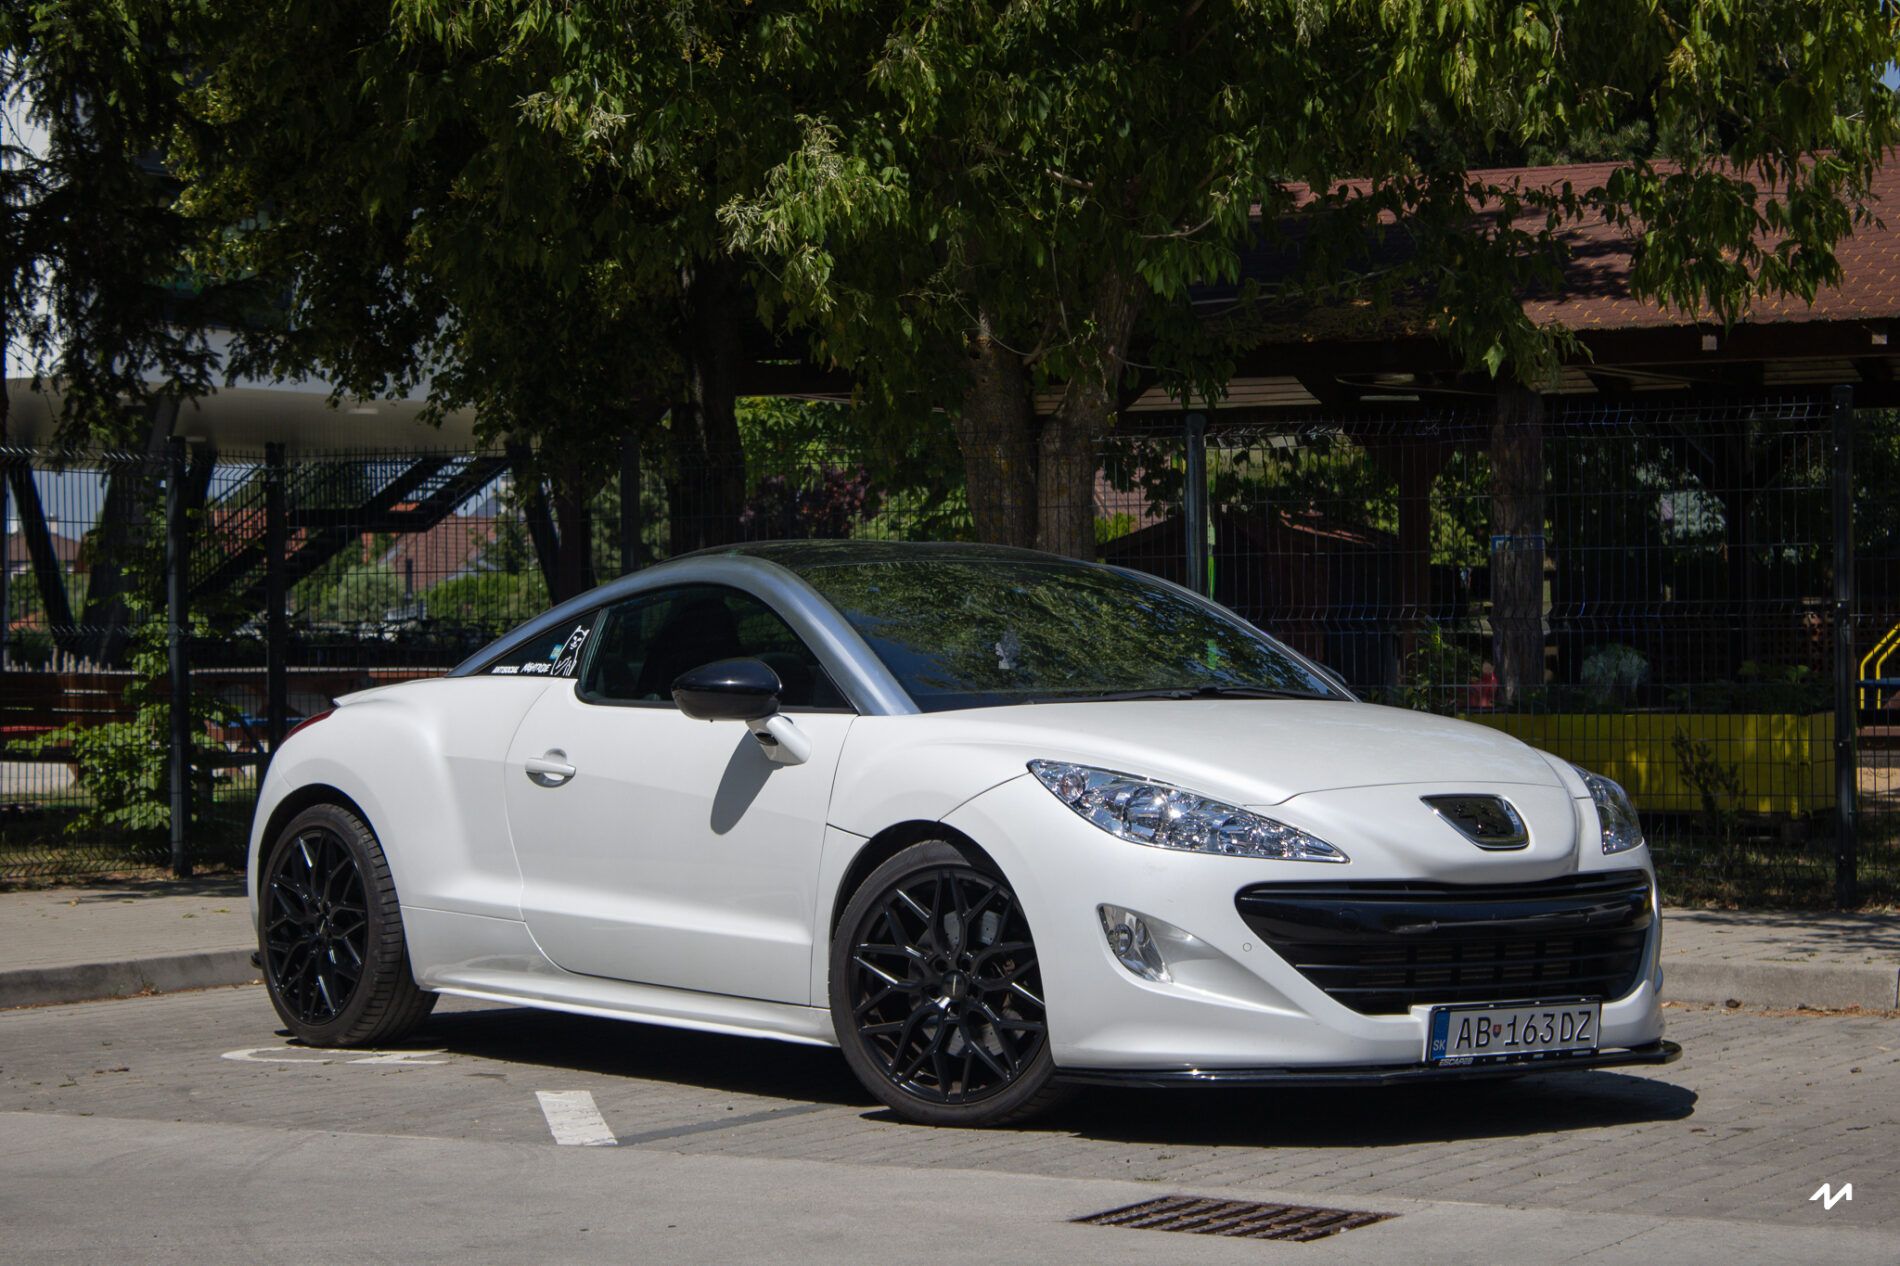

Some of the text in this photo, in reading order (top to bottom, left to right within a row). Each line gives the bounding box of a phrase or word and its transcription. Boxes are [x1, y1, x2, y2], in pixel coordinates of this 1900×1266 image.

[1454, 1010, 1592, 1049] AB 163DZ
[1433, 1039, 1446, 1051] SK
